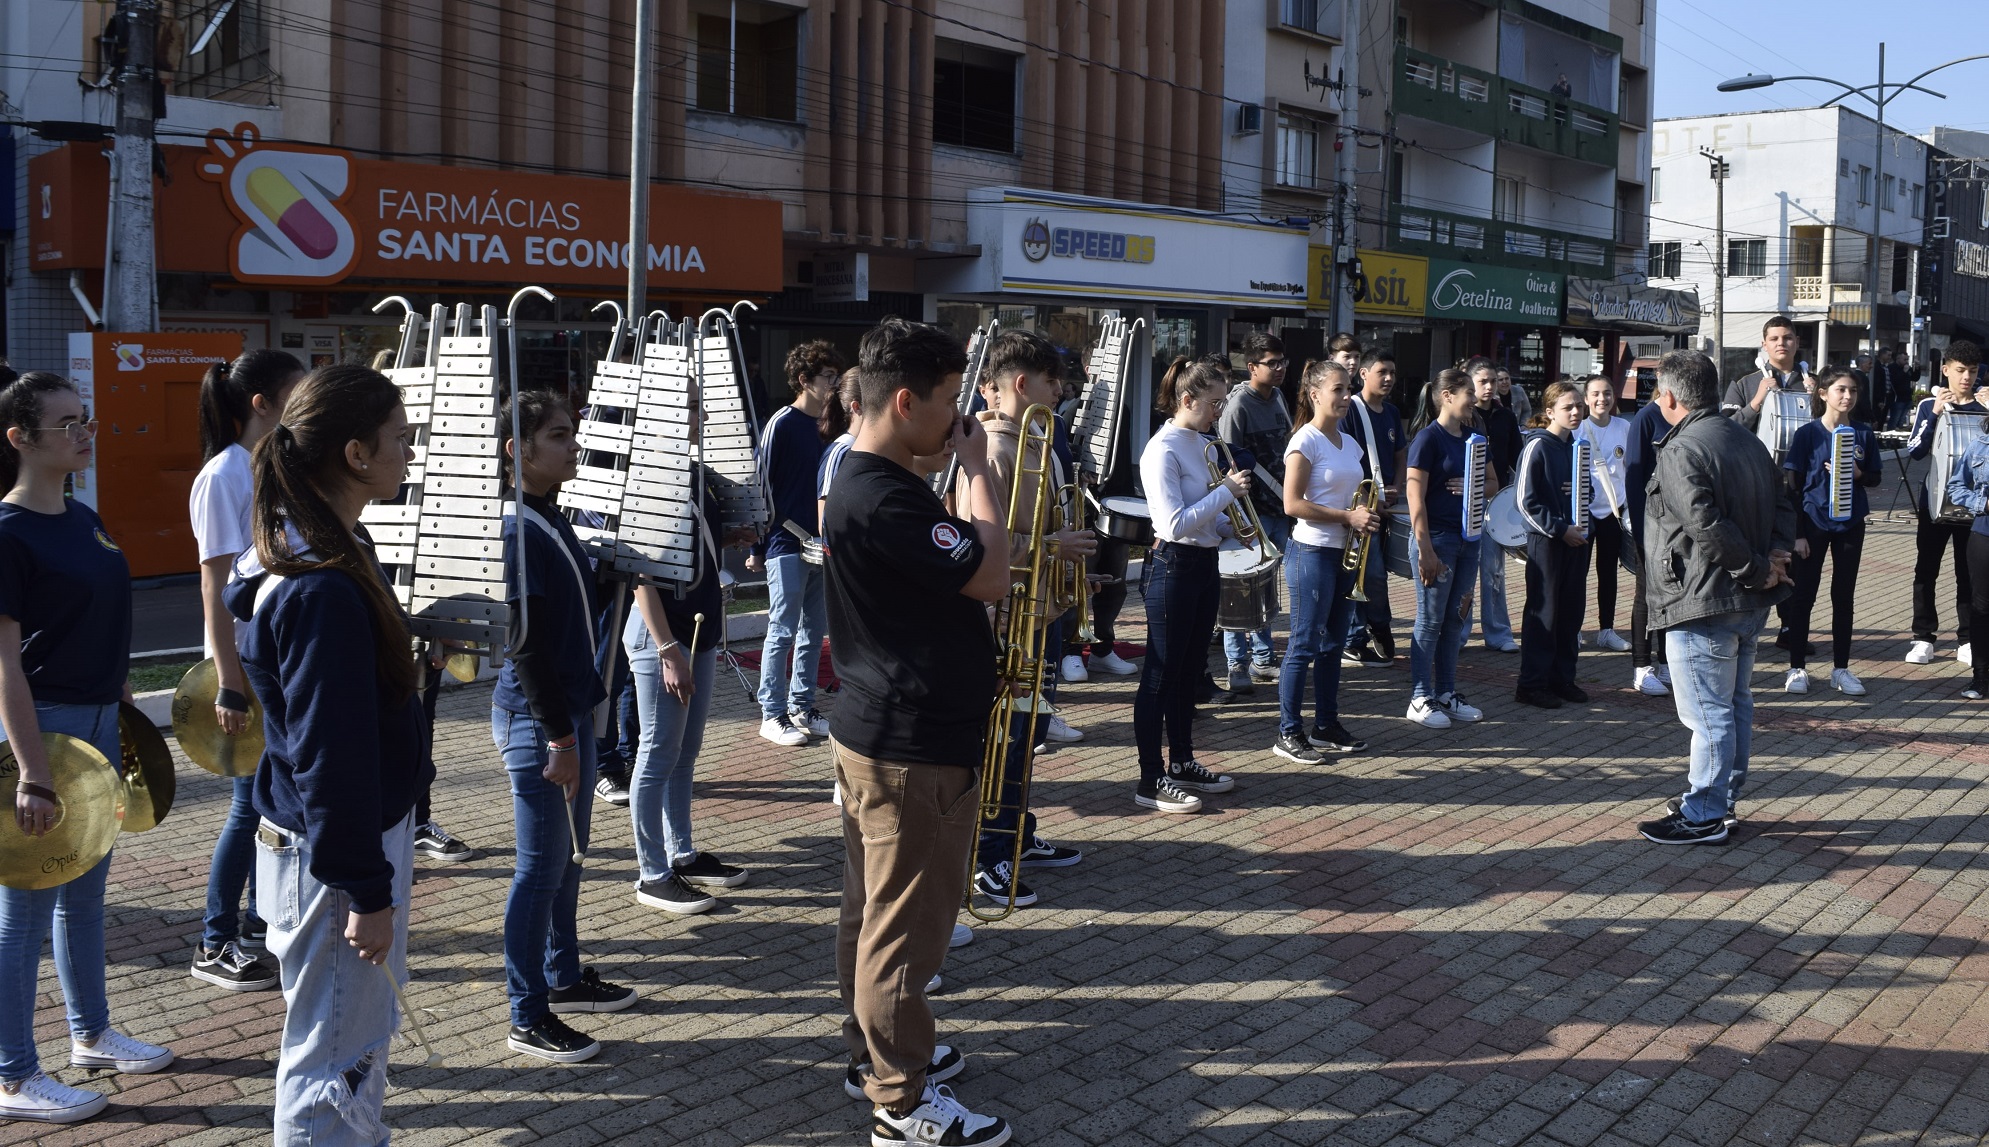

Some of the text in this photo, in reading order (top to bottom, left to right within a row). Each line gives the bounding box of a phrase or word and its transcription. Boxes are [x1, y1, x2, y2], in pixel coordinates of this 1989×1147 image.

[1653, 121, 1767, 157] OTEL
[378, 188, 581, 232] FARMÁCIAS
[377, 228, 706, 273] SANTA ECONMIA
[1431, 268, 1513, 311] Getelina
[1525, 272, 1557, 295] Ótica &
[1519, 300, 1559, 317] Joalheria
[1625, 299, 1669, 323] TREVISOL
[145, 347, 194, 356] FARMÁCIAS
[313, 339, 333, 347] VISA
[145, 356, 226, 364] SANTA ECONOMIA
[950, 538, 969, 557] EDUCAÇÃO
[40, 849, 79, 875] Opus
